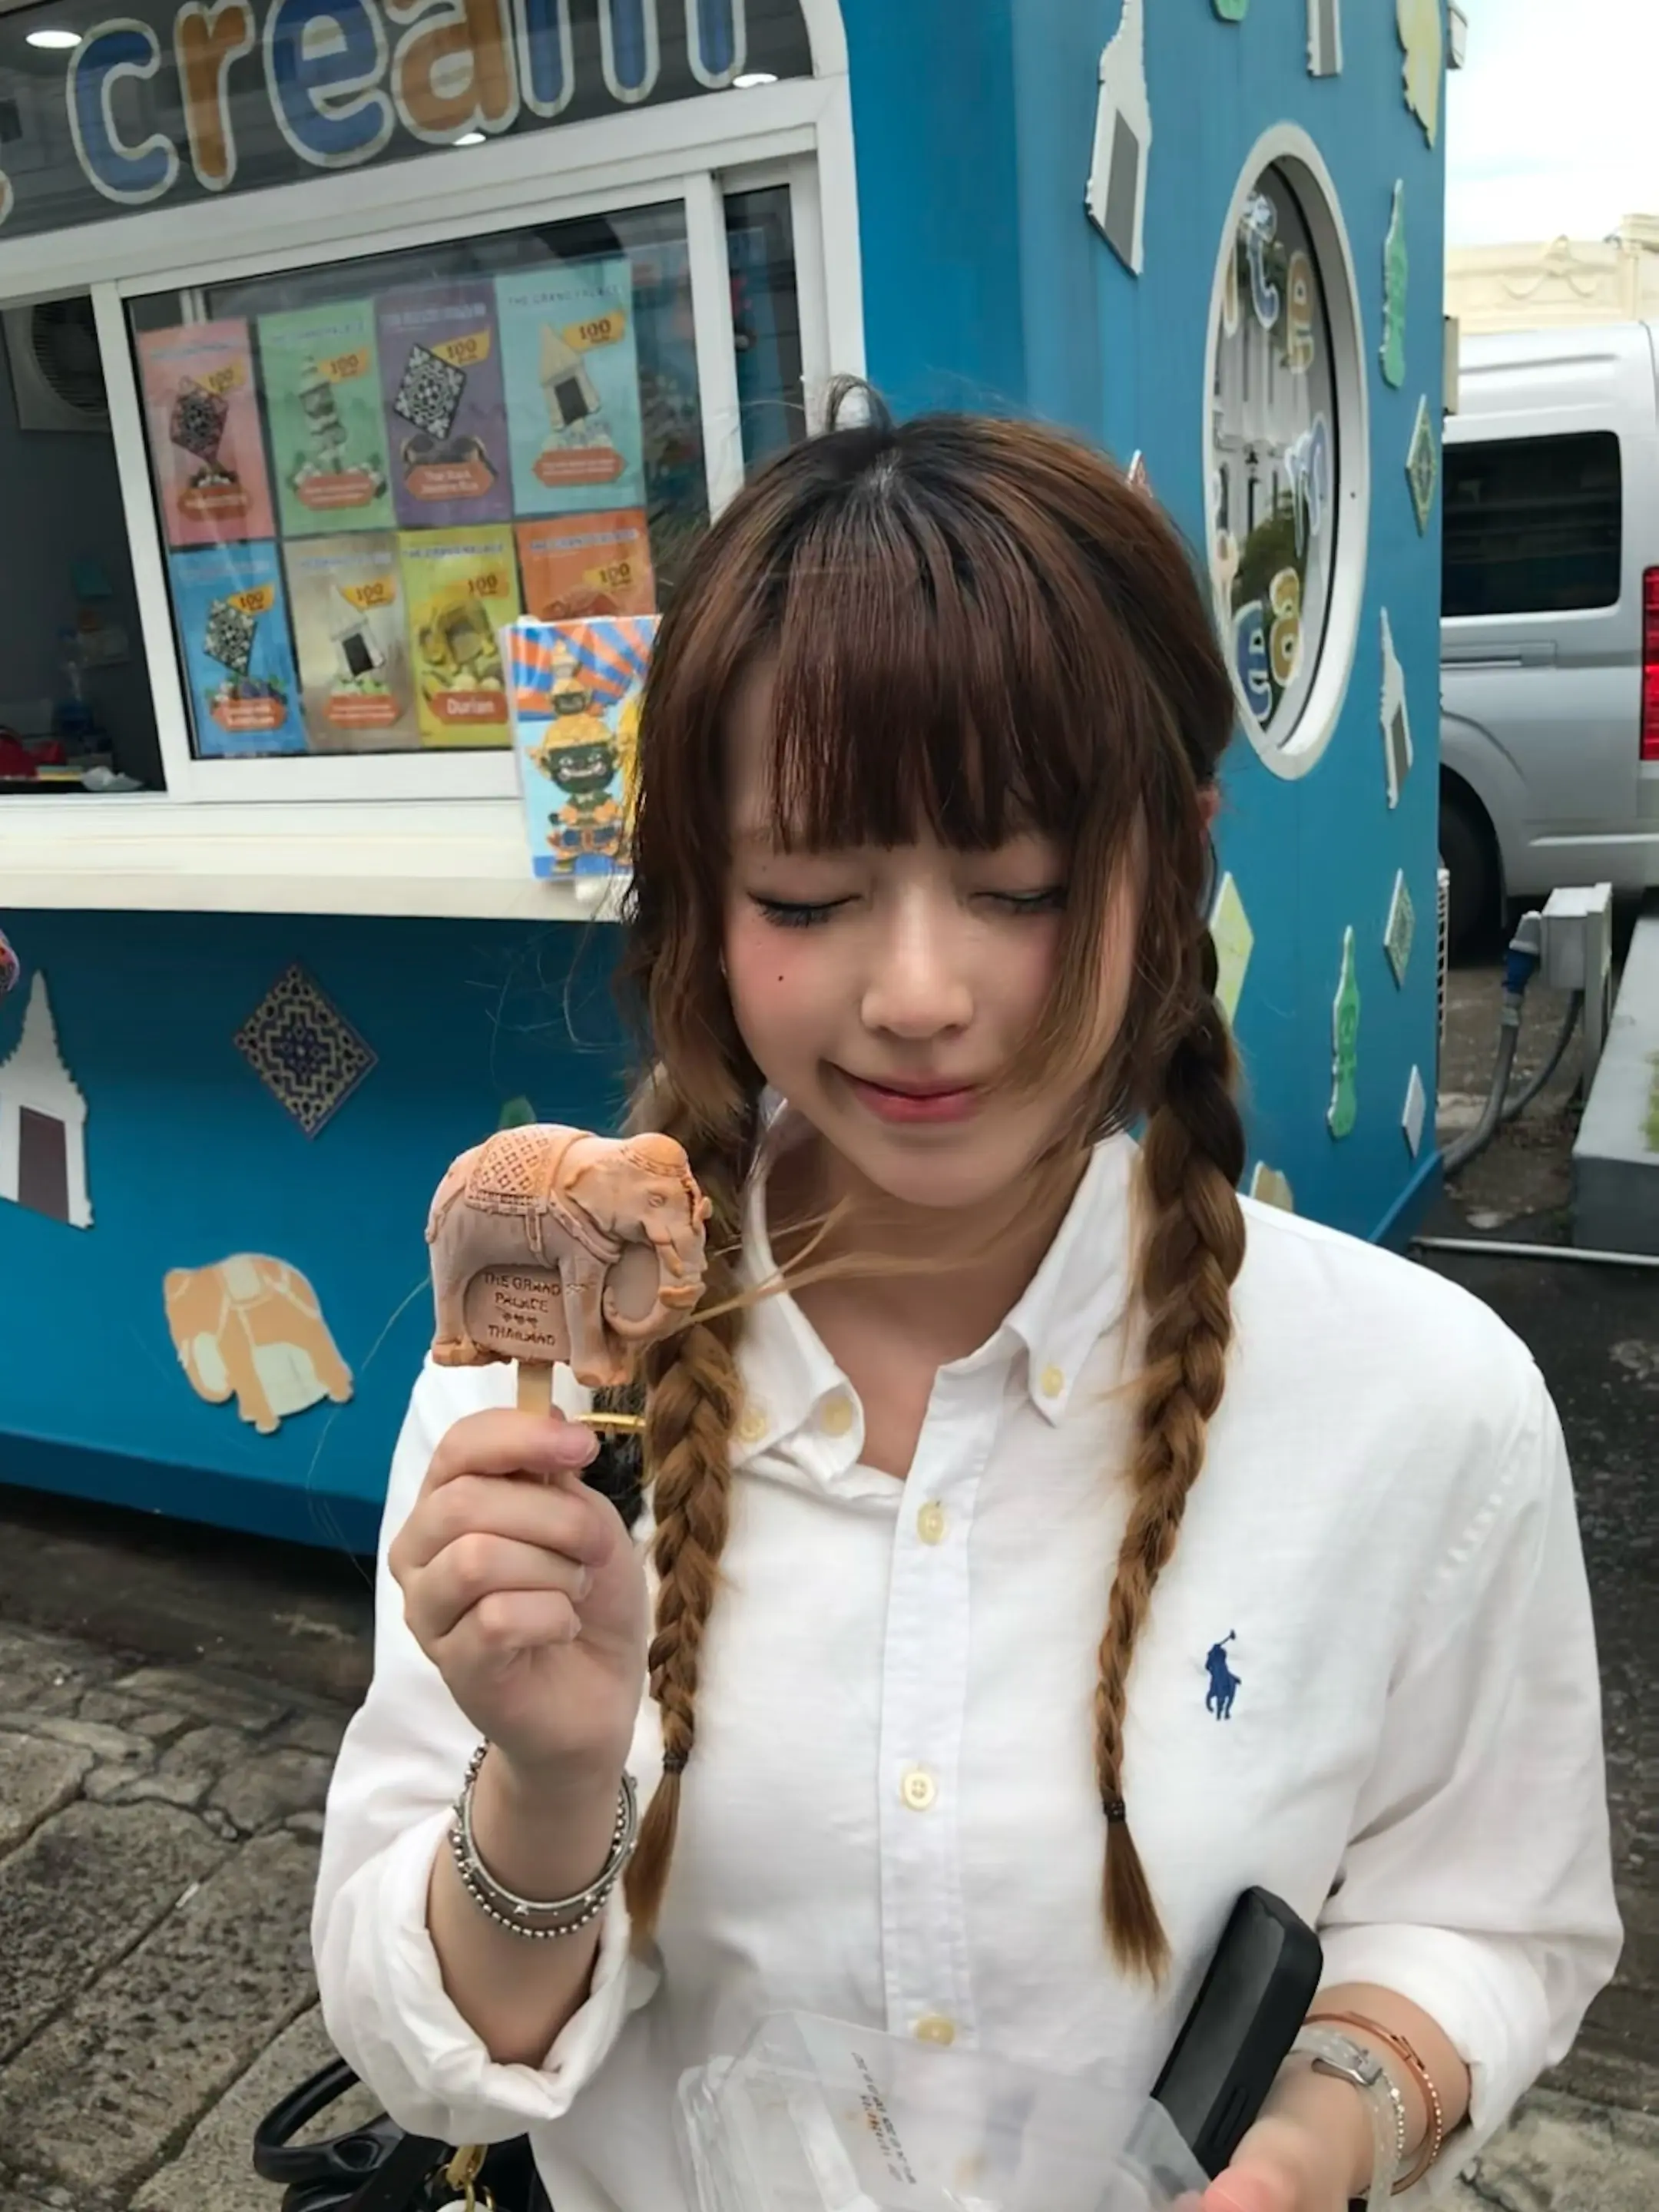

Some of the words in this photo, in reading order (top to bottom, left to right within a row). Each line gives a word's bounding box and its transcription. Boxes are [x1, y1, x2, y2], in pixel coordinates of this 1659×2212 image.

[579, 317, 611, 340] 100
[446, 337, 478, 359] 100
[468, 572, 498, 594] 100
[599, 562, 631, 584] 100
[239, 592, 265, 609] 100
[356, 583, 383, 602] 100
[446, 697, 495, 715] Durian
[512, 1277, 562, 1297] GRAND
[495, 1291, 549, 1313] PALACE
